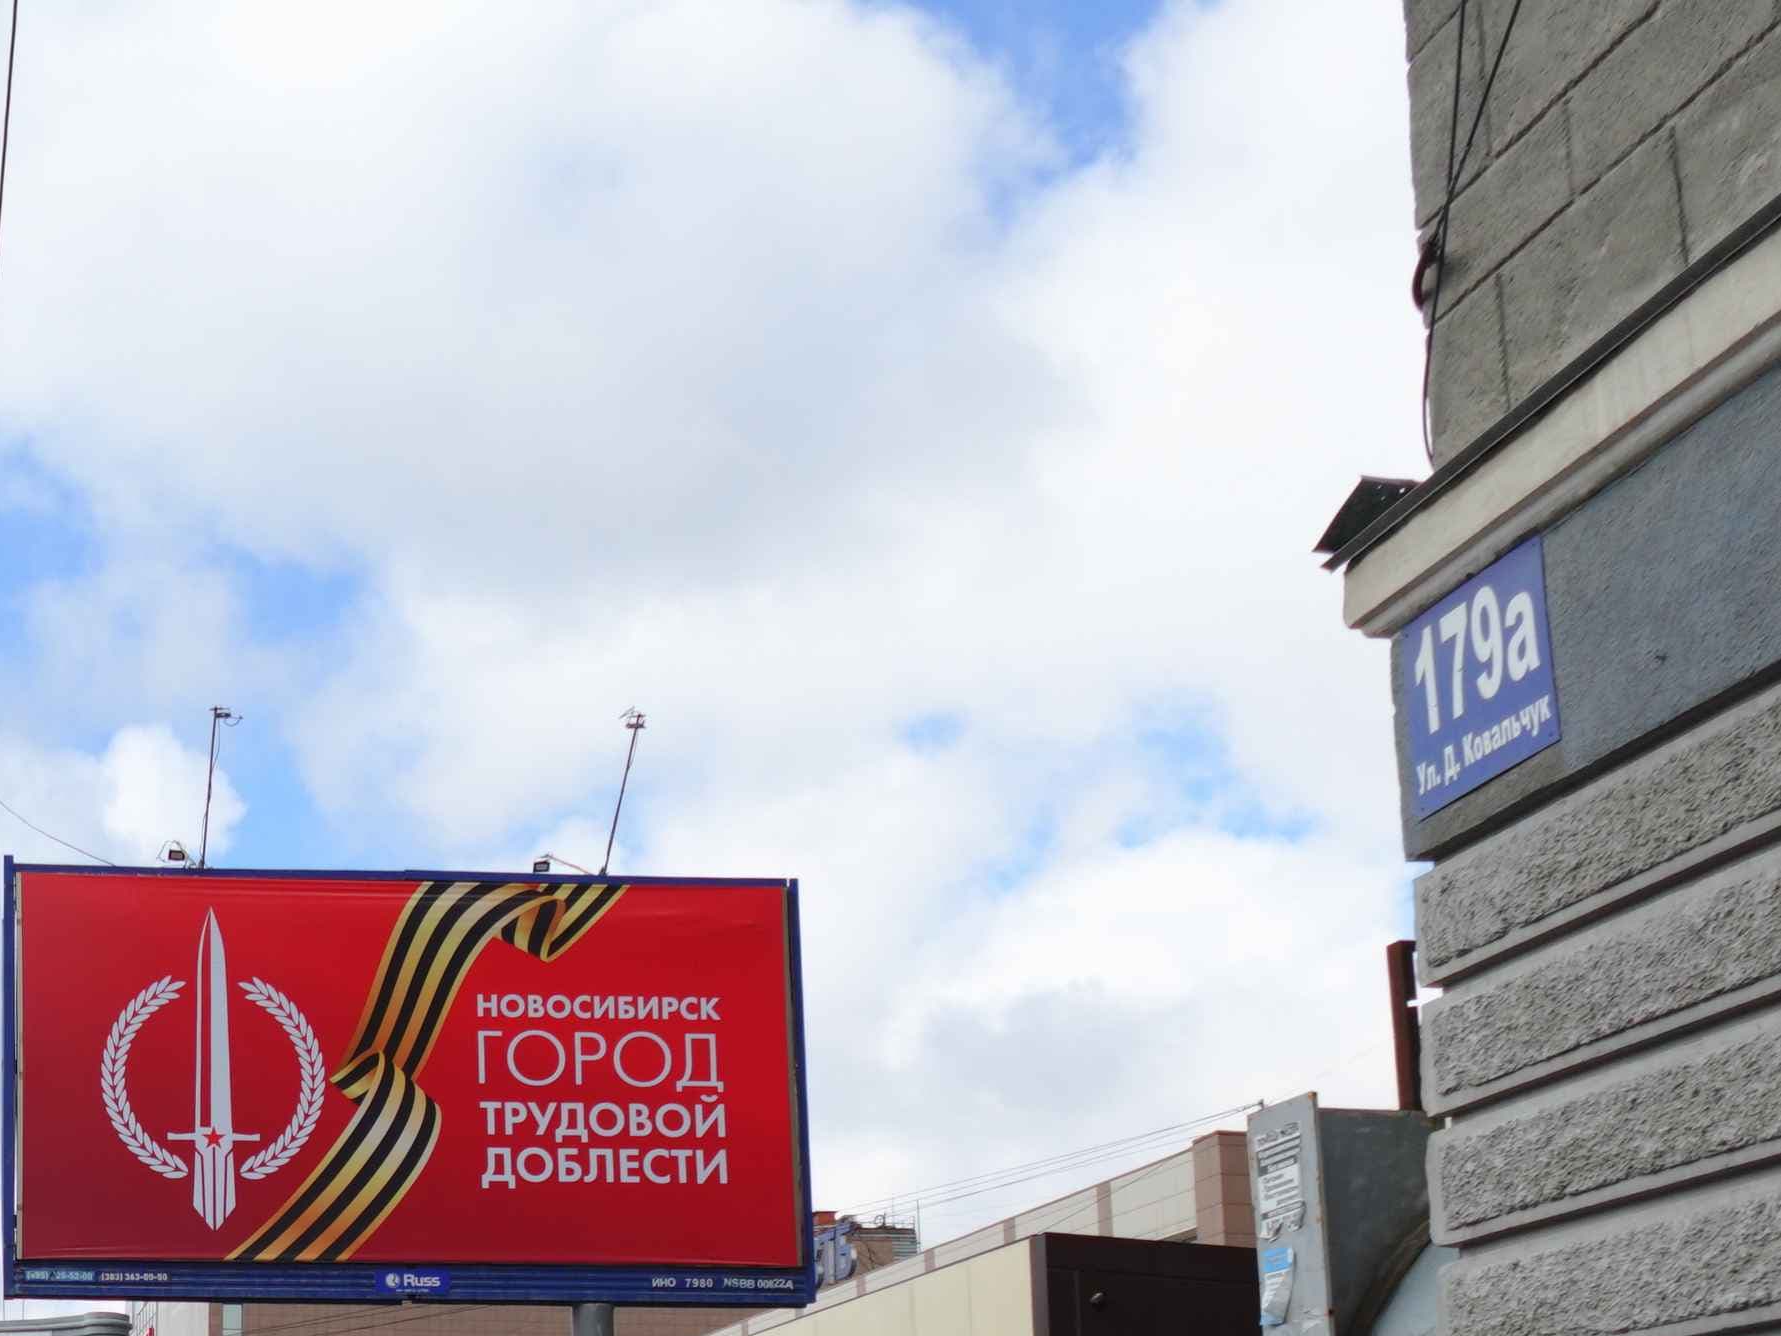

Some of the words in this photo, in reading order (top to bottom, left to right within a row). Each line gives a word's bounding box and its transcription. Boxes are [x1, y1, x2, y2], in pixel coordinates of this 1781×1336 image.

[1415, 585, 1541, 734] 179а
[1416, 760, 1441, 795] Ул.
[1444, 744, 1461, 785] Д.
[1462, 695, 1552, 767] Ковальчук
[476, 993, 721, 1021] НОВОСИБИРСК
[477, 1030, 725, 1092] ГОРОД
[480, 1095, 728, 1143] ТРУДОВОЙ
[481, 1147, 730, 1189] ДОБЛЕСТИ
[403, 1273, 441, 1287] Russ
[652, 1277, 676, 1288] ИНО
[685, 1278, 714, 1288] 7980
